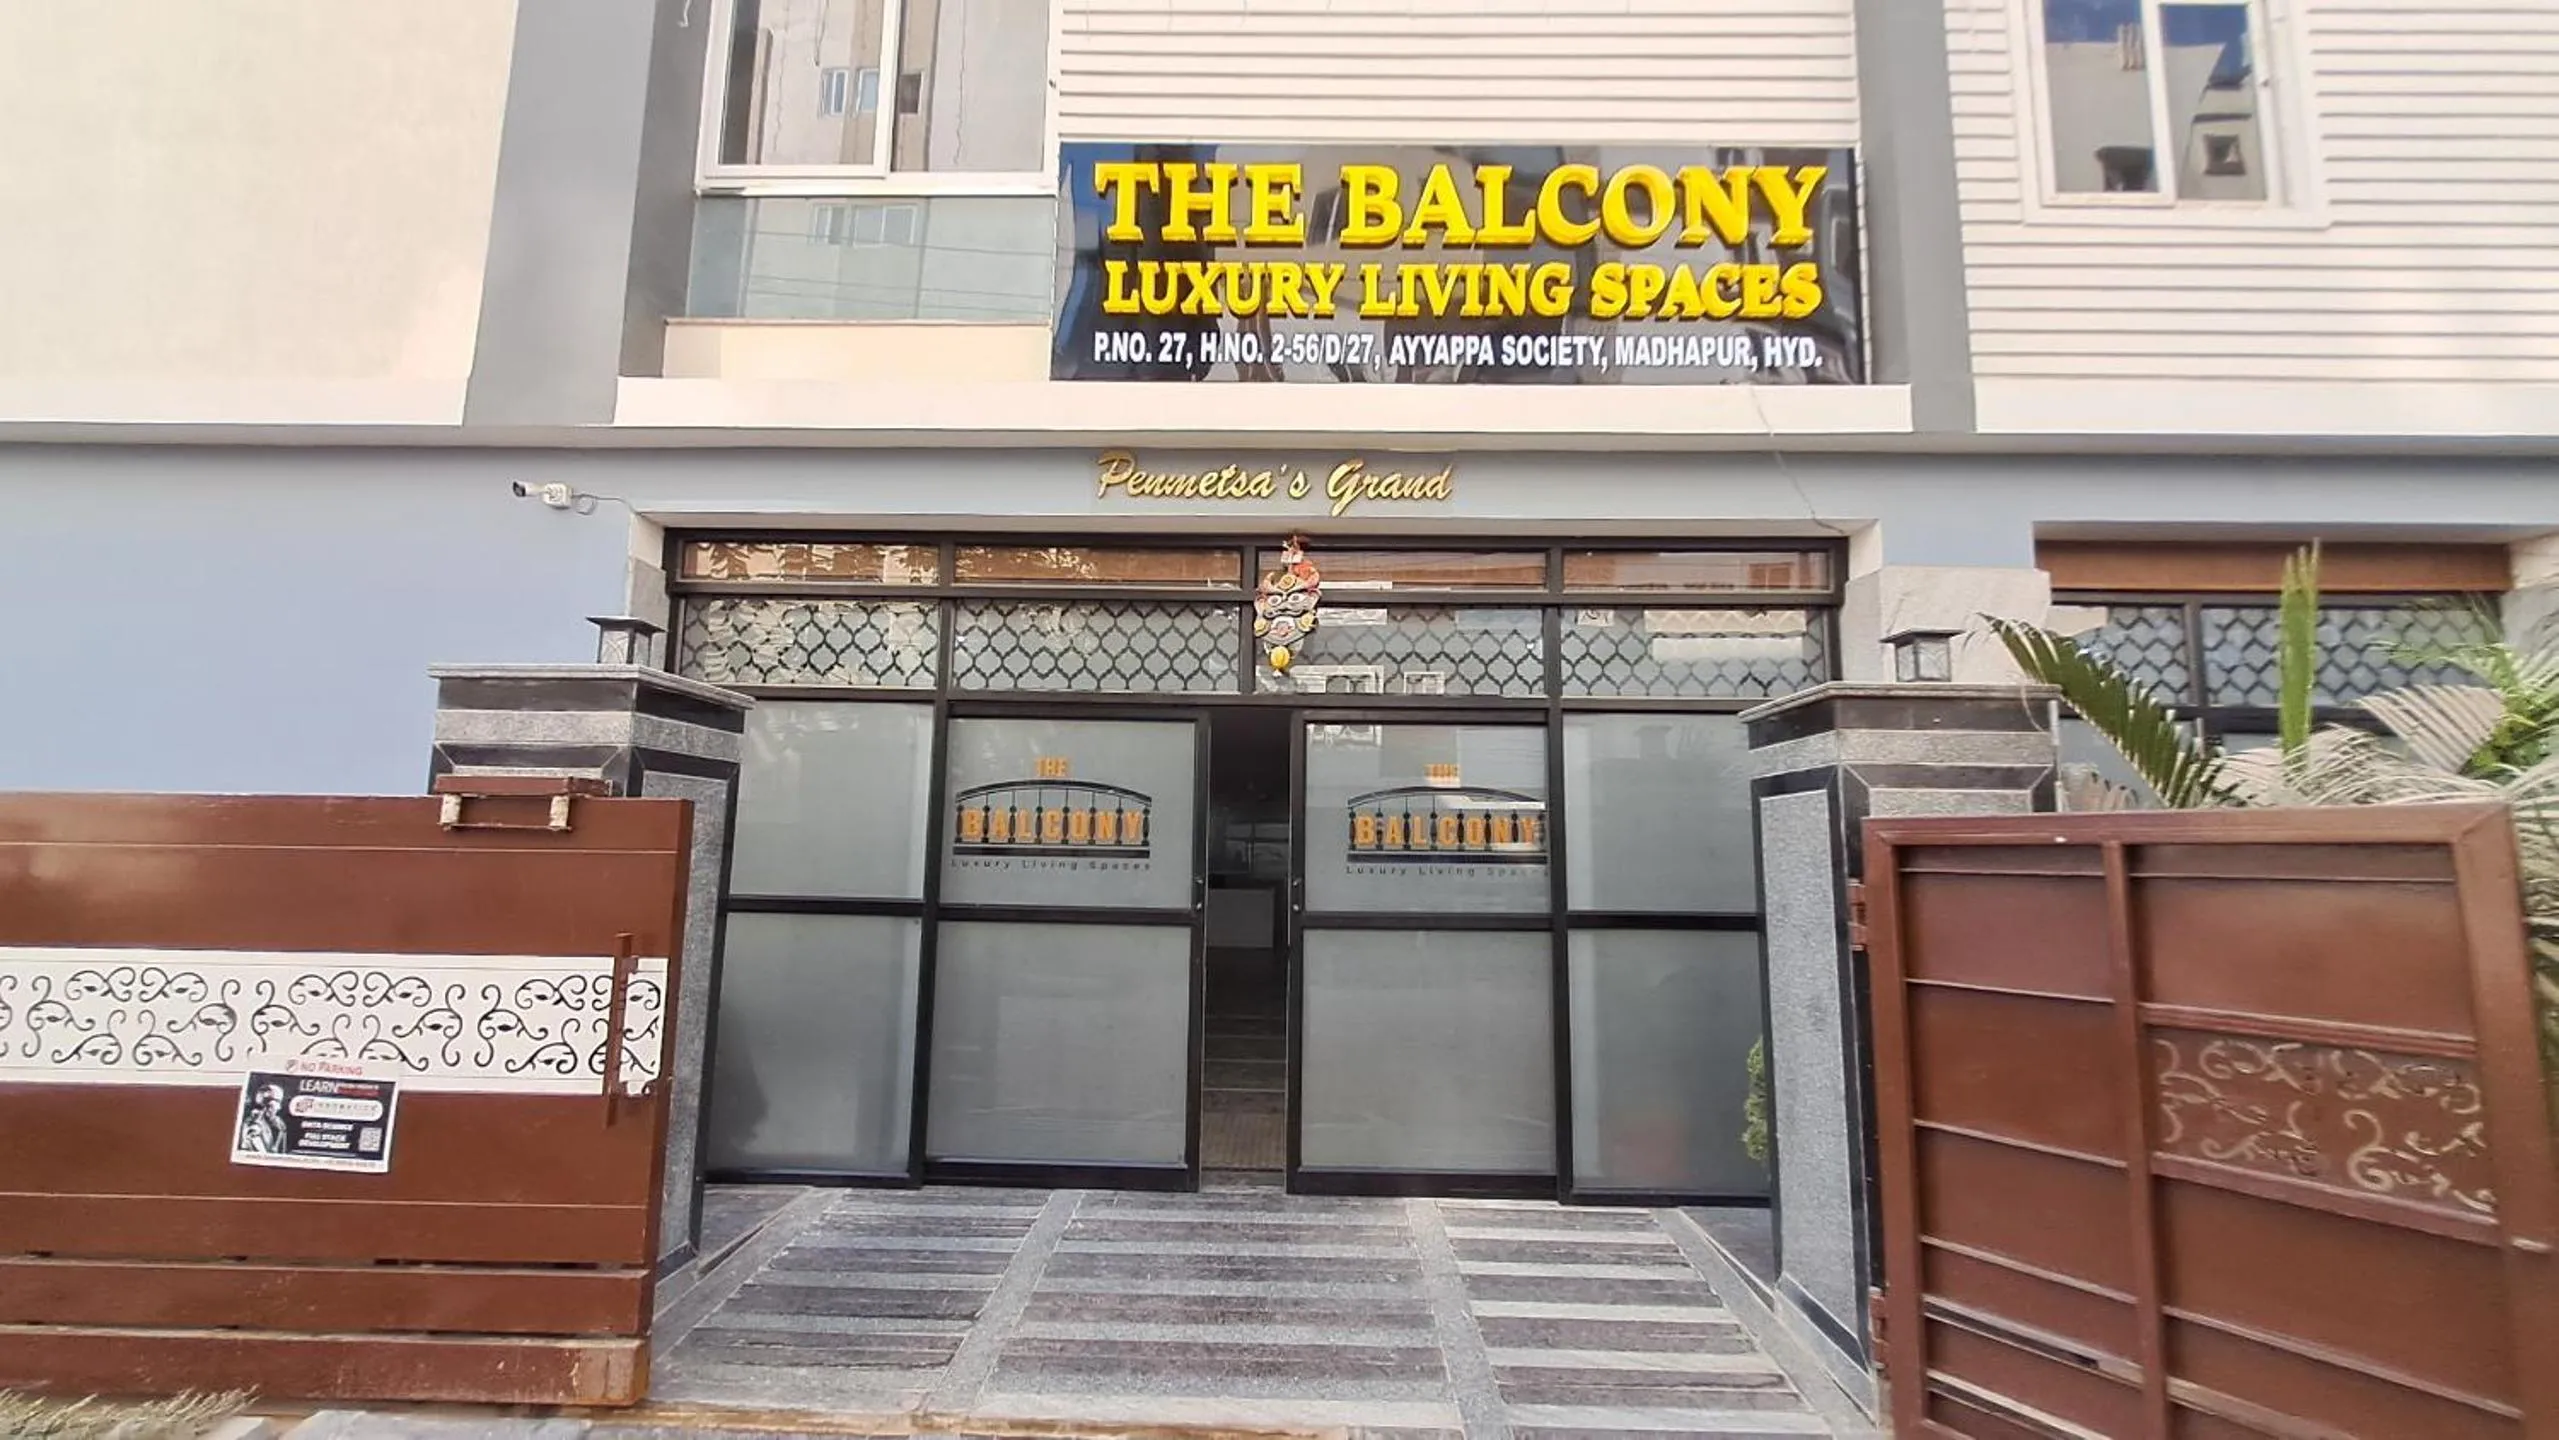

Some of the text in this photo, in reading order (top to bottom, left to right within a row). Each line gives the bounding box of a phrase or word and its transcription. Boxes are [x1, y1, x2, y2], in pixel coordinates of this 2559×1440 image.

[1094, 163, 1827, 248] THE BALCONY
[1103, 260, 1824, 321] LUXURY LIVING SPACES
[1094, 331, 1823, 373] P.NO. 27, H.NO. 2-56/D/27, AYYAPPA SOCIETY, MADHAPUR, HYD.
[1098, 451, 1453, 518] Penmetsa's Grand
[1035, 757, 1070, 777] THE
[962, 807, 1142, 841] BALCONY
[1356, 814, 1537, 846] BALCONY
[951, 859, 1150, 873] Luxury Living Spaces
[1345, 866, 1407, 877] Luxury
[1418, 866, 1476, 878] Living
[301, 1061, 363, 1076] NO PARKING
[300, 1079, 338, 1094] LEARN
